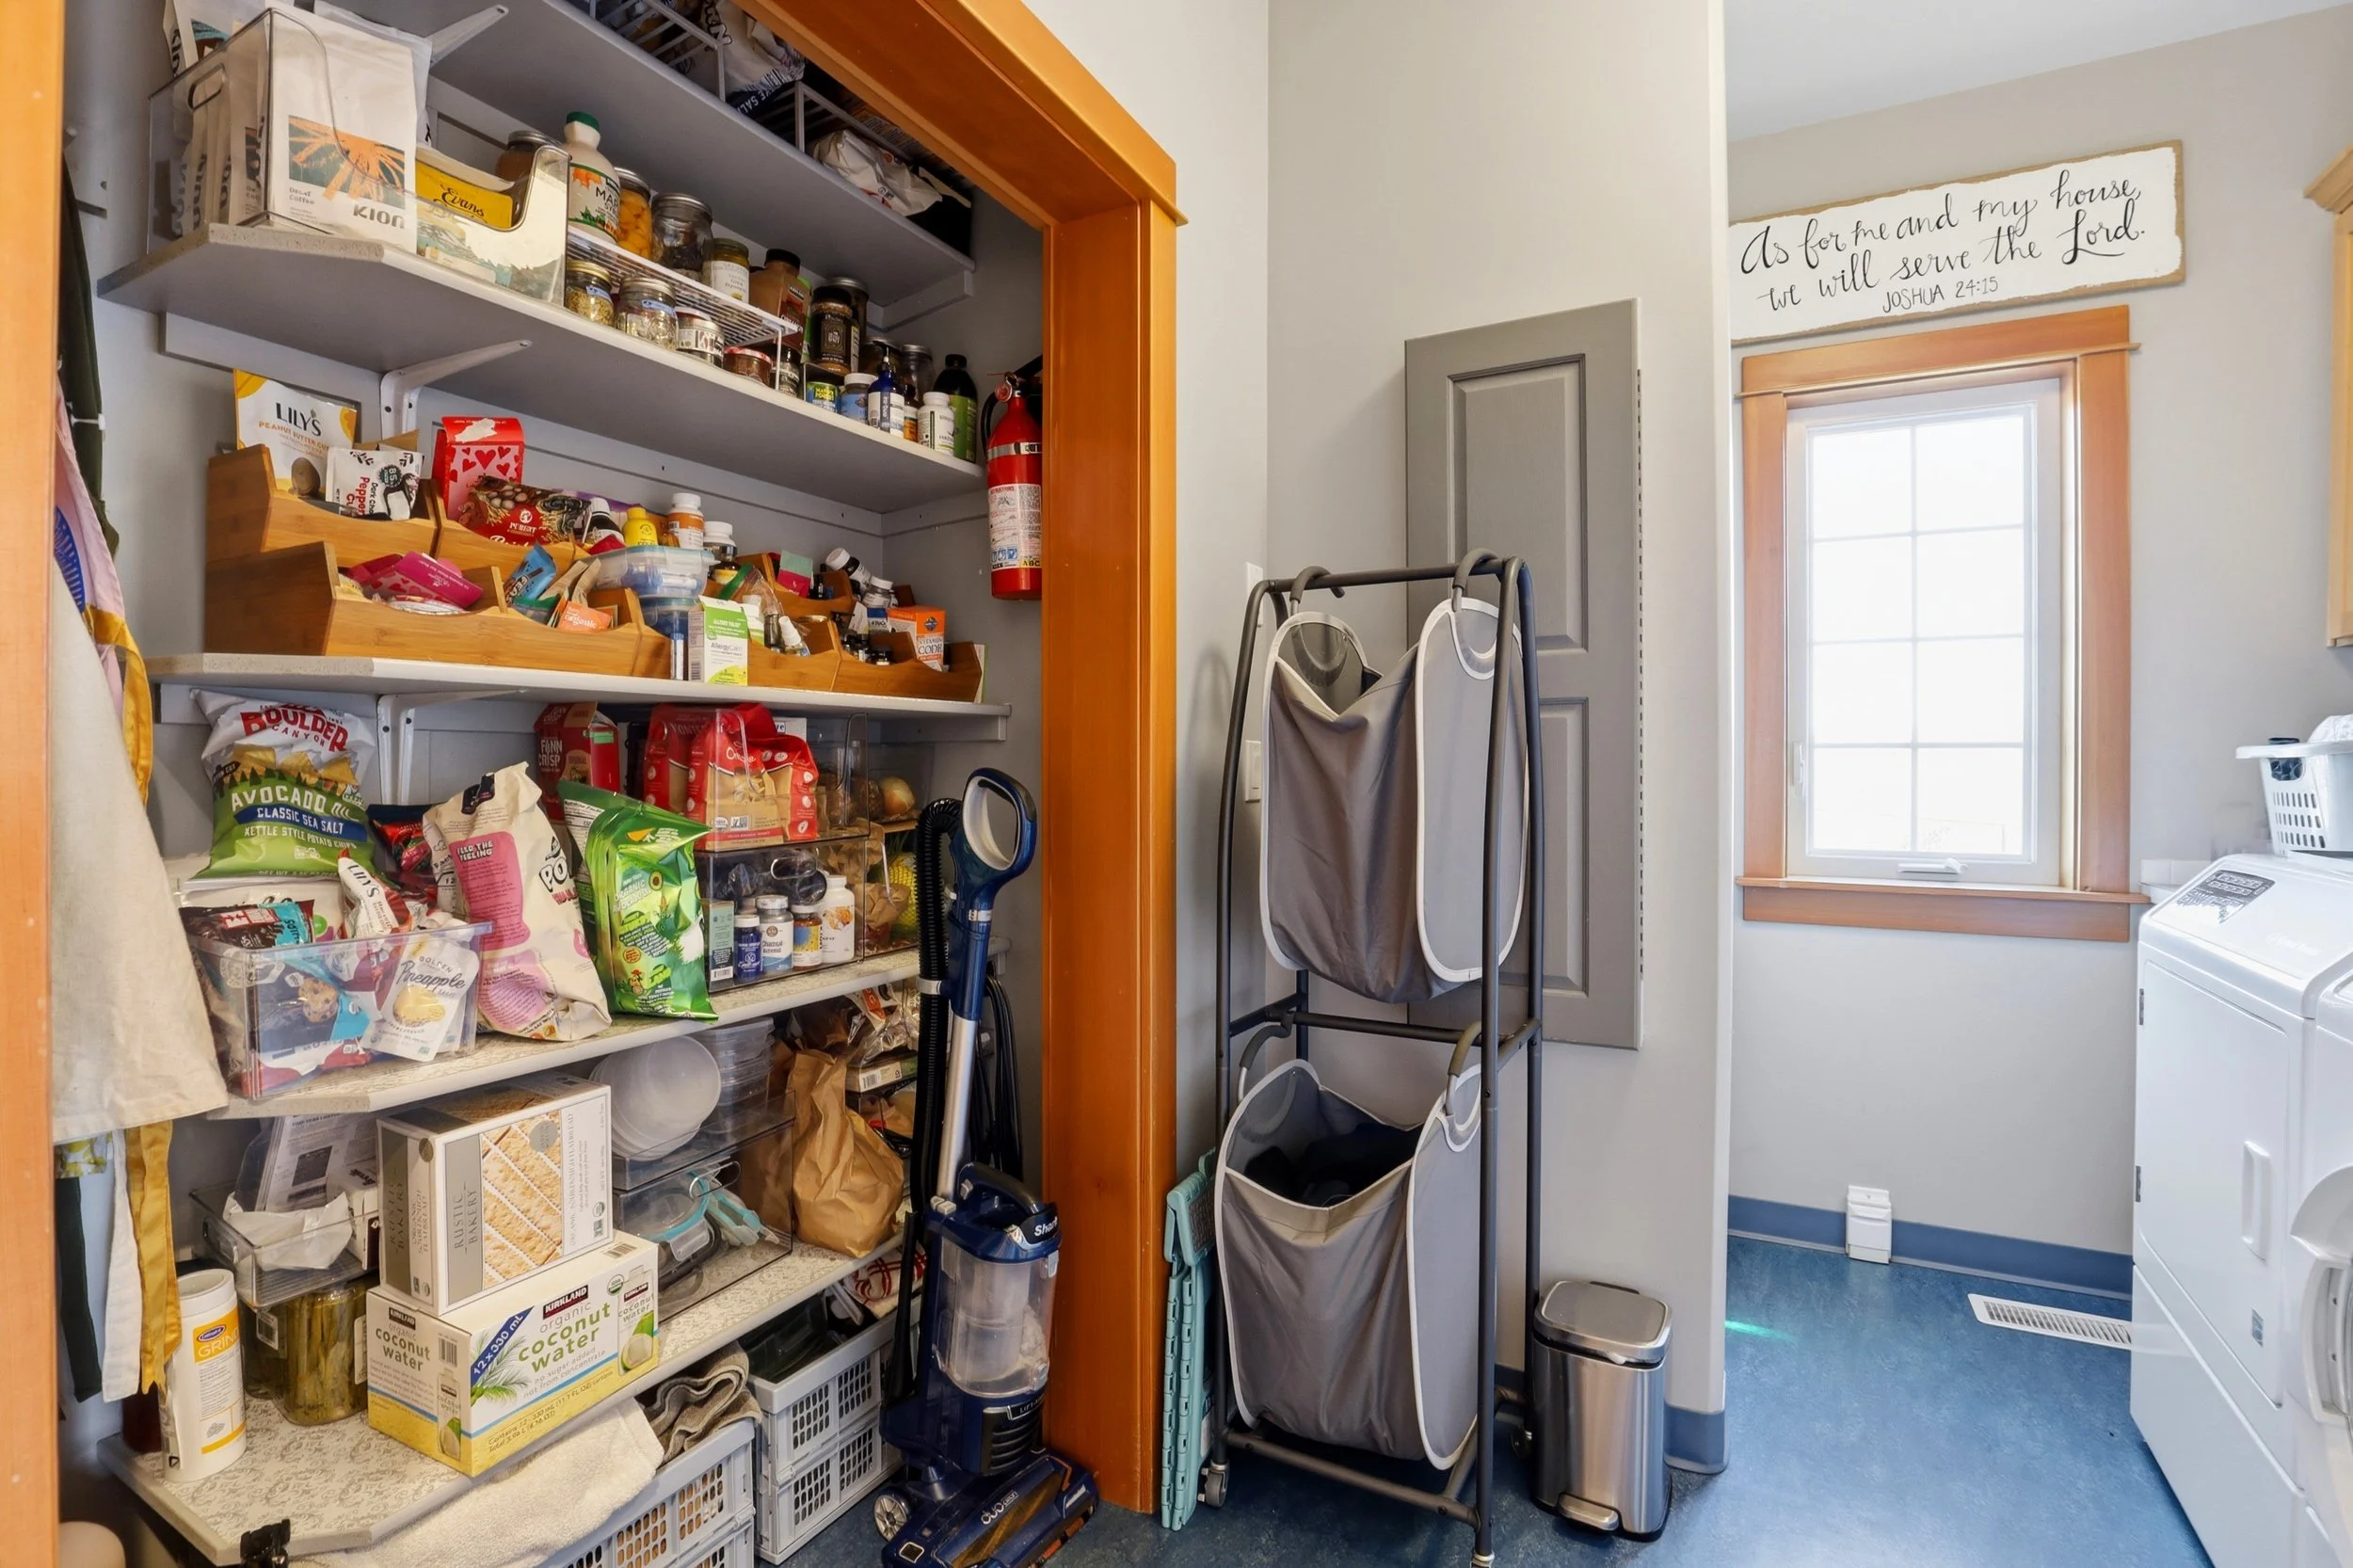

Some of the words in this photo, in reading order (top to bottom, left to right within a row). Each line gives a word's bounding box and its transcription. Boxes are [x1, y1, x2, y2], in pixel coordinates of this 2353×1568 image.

[435, 184, 486, 218] Evans
[1741, 225, 1789, 274] As
[1797, 217, 1847, 269] for
[1850, 219, 1890, 246] me
[1897, 192, 1959, 240] and
[1973, 196, 2039, 237] my
[2050, 169, 2141, 211] house,
[1756, 283, 1801, 312] we
[1818, 248, 1881, 298] will
[1889, 248, 1971, 280] serve
[1981, 225, 2042, 264] the
[2056, 198, 2146, 264] Lord.
[1882, 283, 1945, 313] JOSHUA
[1955, 275, 1999, 299] 24:15
[355, 475, 371, 517] Pepper
[240, 706, 349, 752] BOULDER
[271, 723, 326, 748] CANYON
[231, 784, 328, 813] AVOCADO
[330, 801, 360, 822] OIL
[257, 807, 300, 823] CLASSIC
[301, 813, 318, 829] SEA
[320, 820, 345, 835] SALT
[244, 825, 279, 837] KETTLE
[282, 826, 306, 840] STYLE
[307, 833, 332, 847] POTATO
[475, 840, 494, 849] THE
[538, 856, 572, 893] PO
[395, 960, 467, 993] Pineapple
[453, 1192, 465, 1250] RUSTIC
[467, 1190, 478, 1245] BAKERY
[539, 1301, 592, 1334] organic
[545, 1287, 588, 1314] KIRKLAND
[622, 1304, 650, 1323] water
[376, 1327, 430, 1362] coconut
[389, 1322, 417, 1340] organic
[472, 1361, 488, 1376] 12
[490, 1331, 509, 1352] 330
[509, 1314, 524, 1330] mL
[519, 1302, 611, 1362] coconut
[382, 1345, 424, 1371] water
[531, 1327, 600, 1374] water
[534, 1375, 544, 1384] no
[548, 1362, 569, 1377] sugar
[570, 1348, 597, 1365] added
[523, 1388, 538, 1399] not
[539, 1377, 558, 1391] from
[560, 1349, 606, 1378] concentrate
